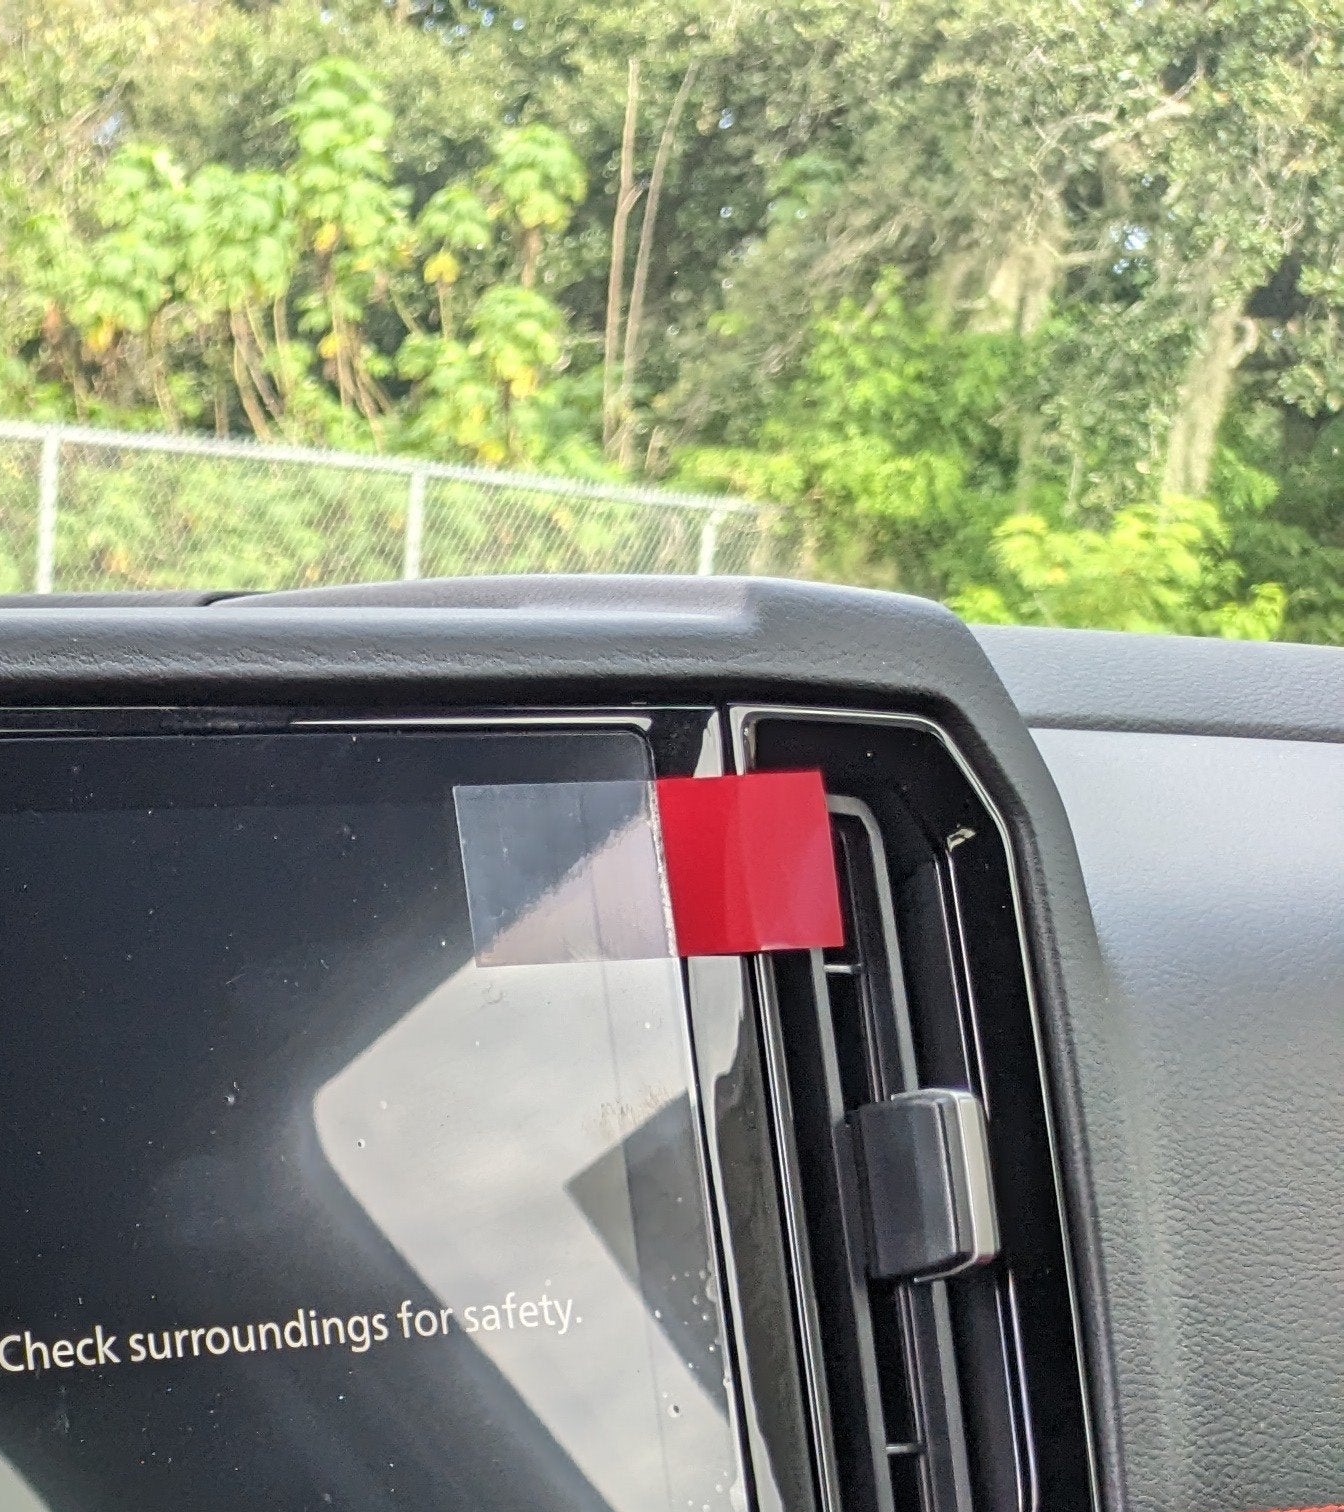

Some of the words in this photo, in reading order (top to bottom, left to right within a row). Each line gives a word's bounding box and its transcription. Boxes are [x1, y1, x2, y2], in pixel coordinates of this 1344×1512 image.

[128, 1309, 389, 1362] surroundings
[396, 1301, 453, 1339] for
[463, 1292, 583, 1335] safety.
